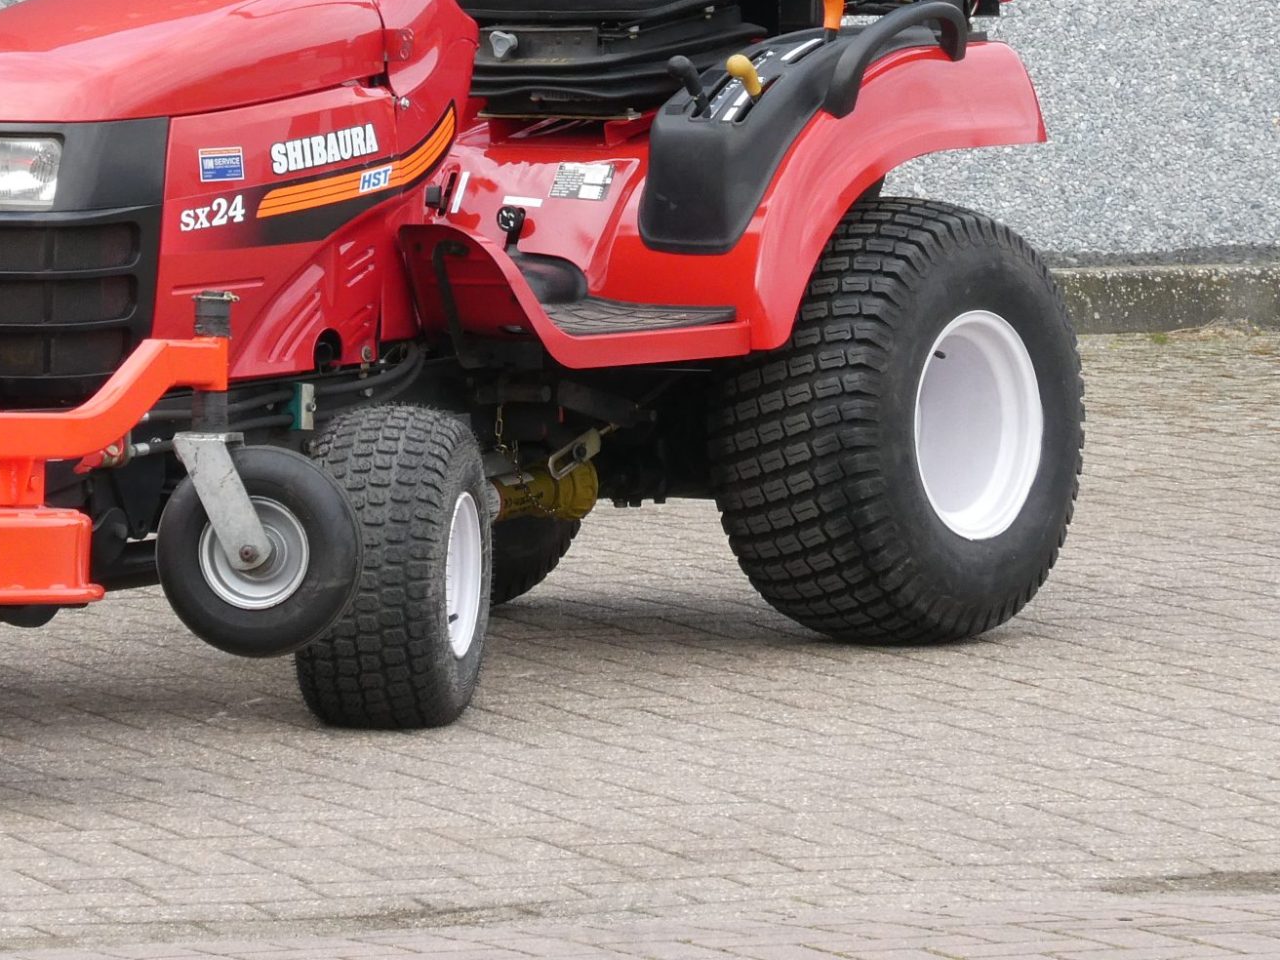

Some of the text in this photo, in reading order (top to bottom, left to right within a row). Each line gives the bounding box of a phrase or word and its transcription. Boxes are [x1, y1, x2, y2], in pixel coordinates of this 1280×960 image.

[270, 123, 379, 174] SHIBAURA
[214, 157, 240, 166] SERVICE
[361, 167, 391, 190] HST
